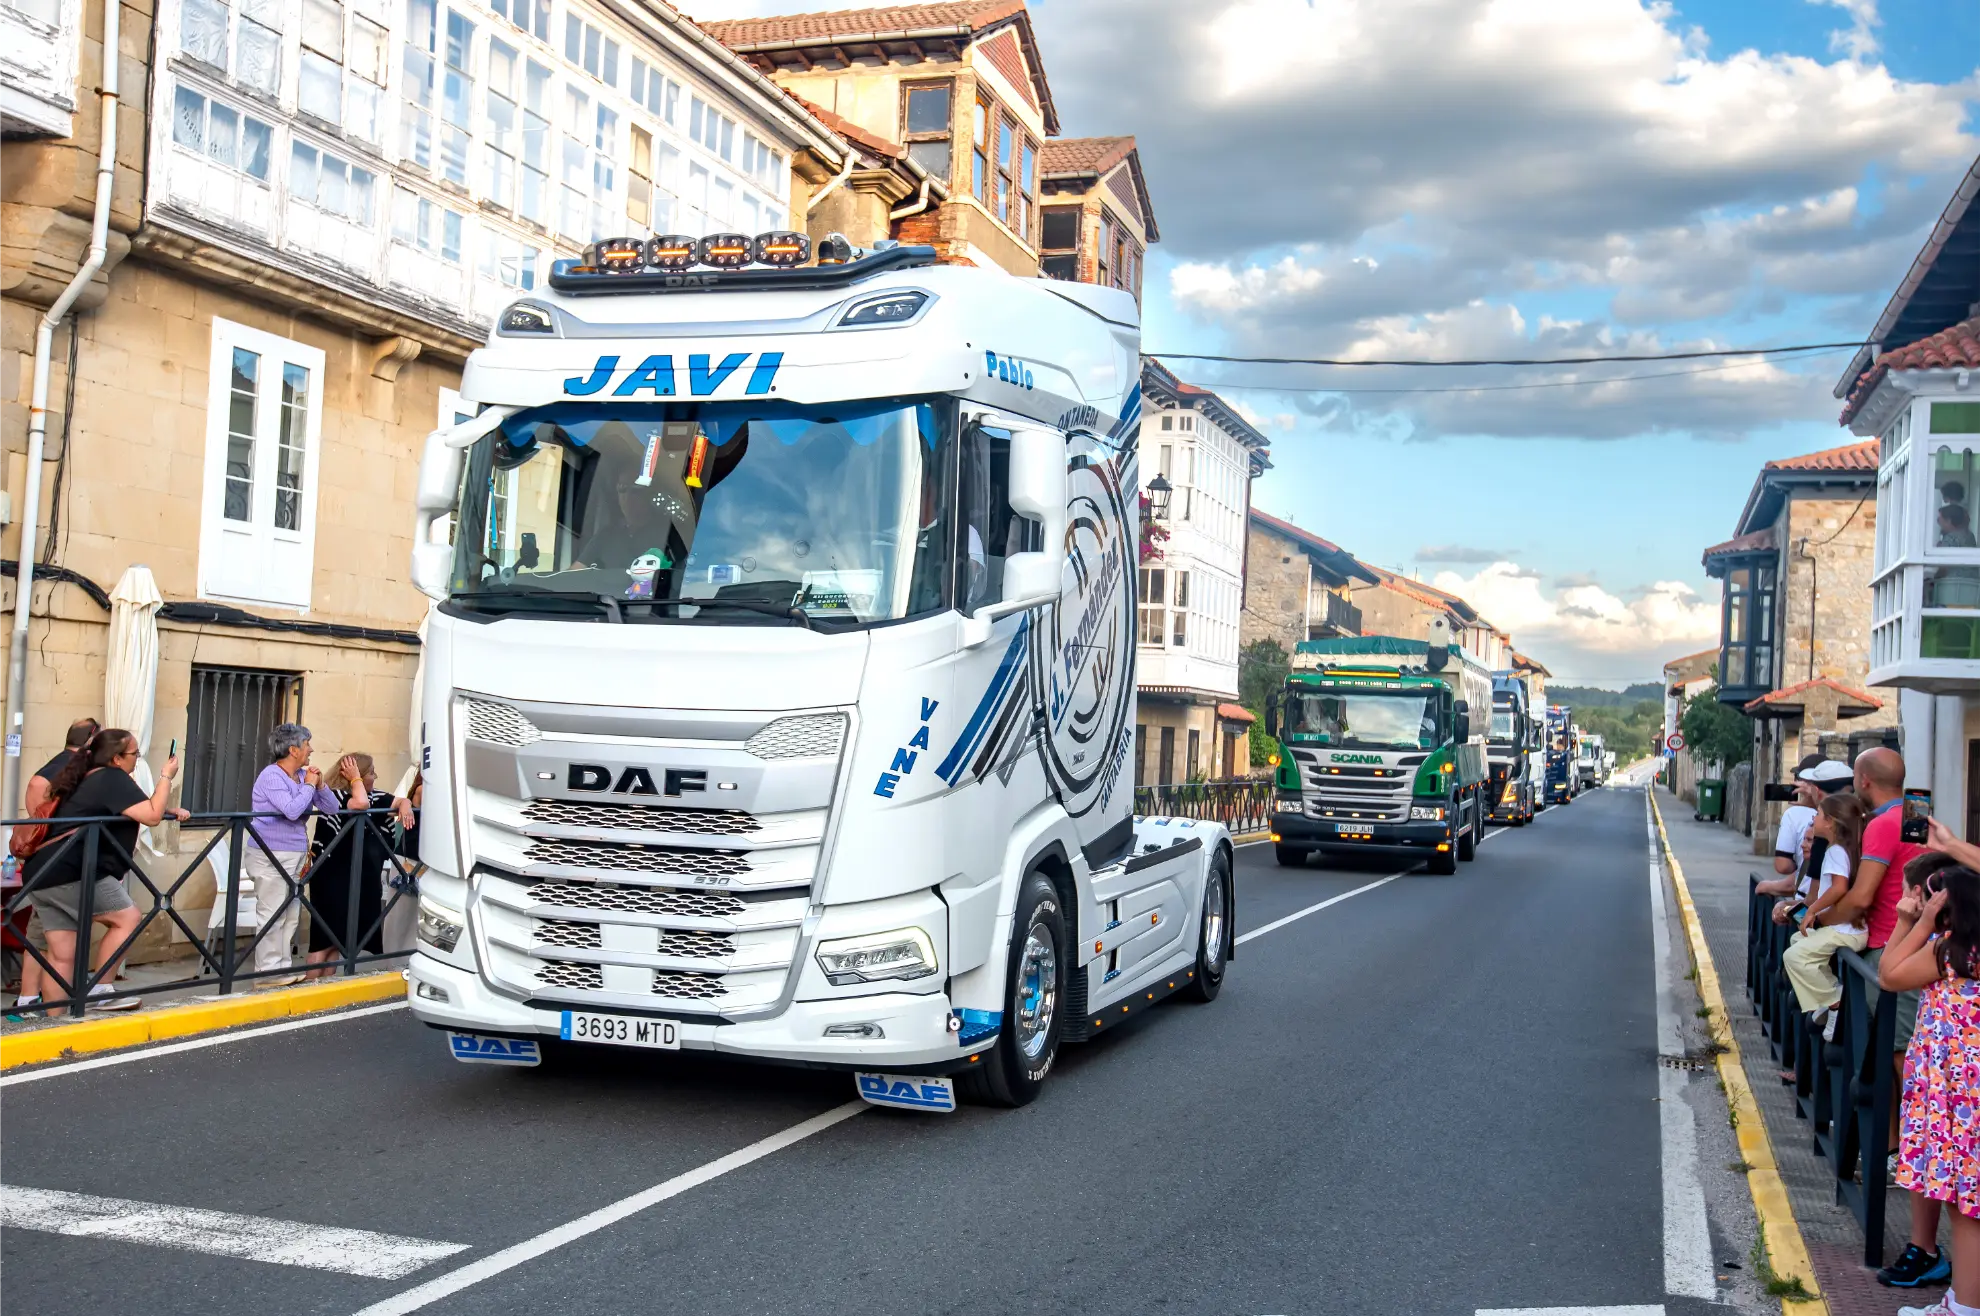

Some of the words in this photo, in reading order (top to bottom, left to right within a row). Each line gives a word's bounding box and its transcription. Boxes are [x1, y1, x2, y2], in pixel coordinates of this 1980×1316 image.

[665, 273, 721, 287] DAF
[563, 352, 785, 397] JAVI
[985, 349, 1034, 391] Pablo
[873, 696, 940, 799] VANE
[1330, 753, 1384, 765] SCANIA
[567, 762, 709, 798] DAF
[1099, 727, 1132, 815] CANTABRIA
[1359, 825, 1373, 833] JLH
[693, 876, 731, 886] 530
[576, 1016, 628, 1040] 3693
[636, 1020, 675, 1045] MTD
[451, 1036, 536, 1054] DAF
[859, 1076, 950, 1101] DAF
